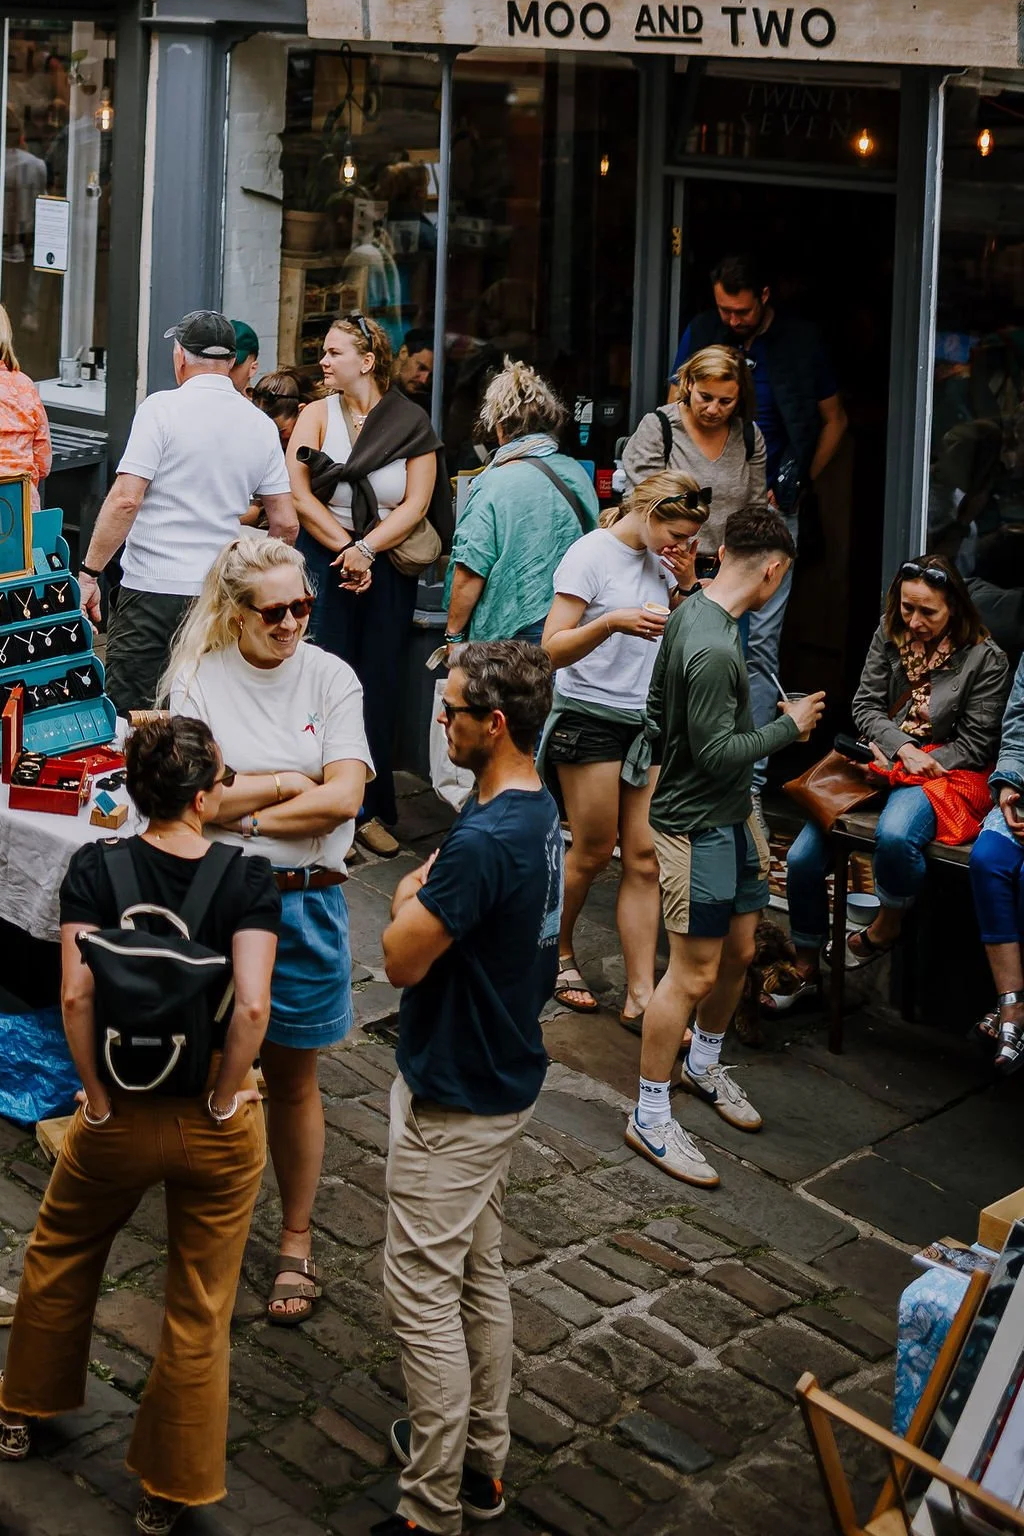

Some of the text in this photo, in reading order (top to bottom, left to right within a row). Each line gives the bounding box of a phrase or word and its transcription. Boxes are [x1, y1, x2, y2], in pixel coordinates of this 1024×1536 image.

[507, 0, 837, 48] MOO AND TWO
[747, 82, 860, 114] TWENTY
[738, 111, 853, 141] SEVEN
[699, 1034, 723, 1044] BO
